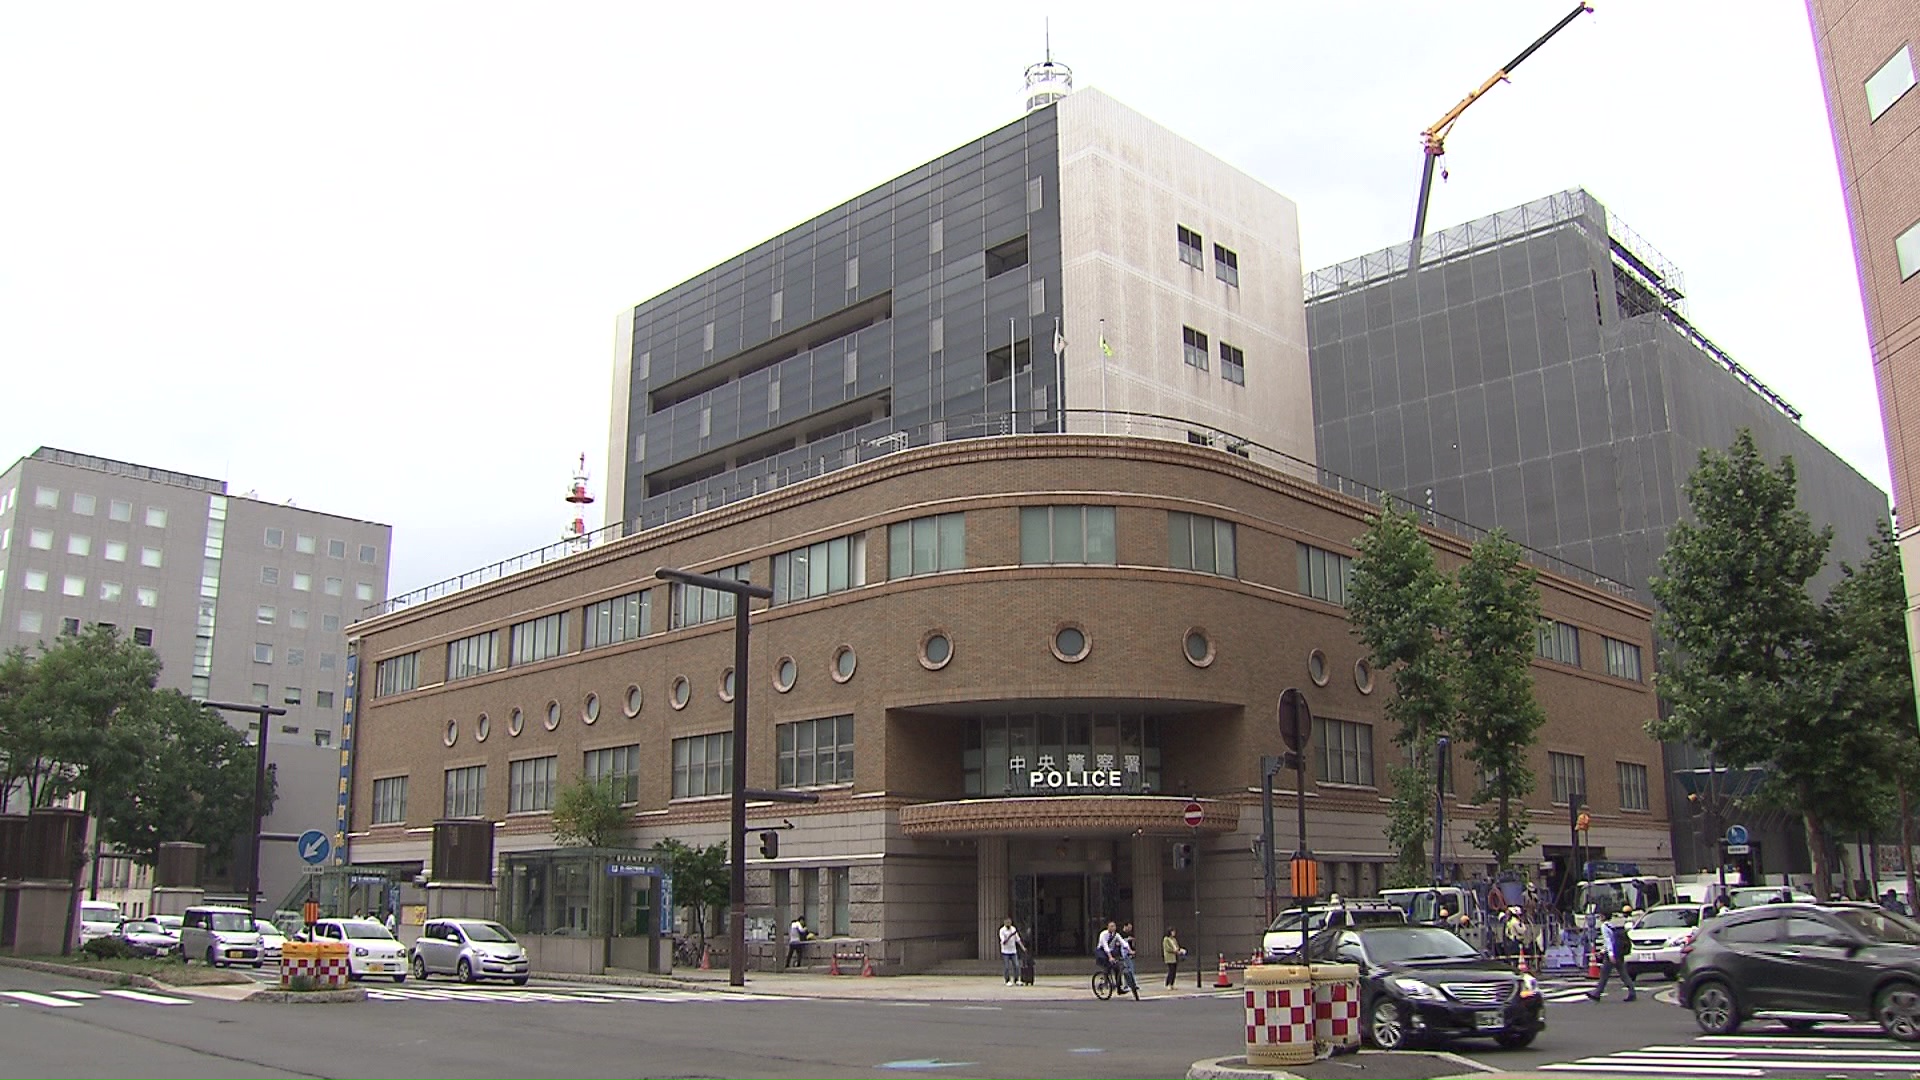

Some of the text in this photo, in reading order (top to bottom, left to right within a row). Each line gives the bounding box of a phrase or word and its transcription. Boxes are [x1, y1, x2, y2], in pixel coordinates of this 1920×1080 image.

[1010, 754, 1140, 774] 中央警察署
[1030, 771, 1122, 788] POLICE
